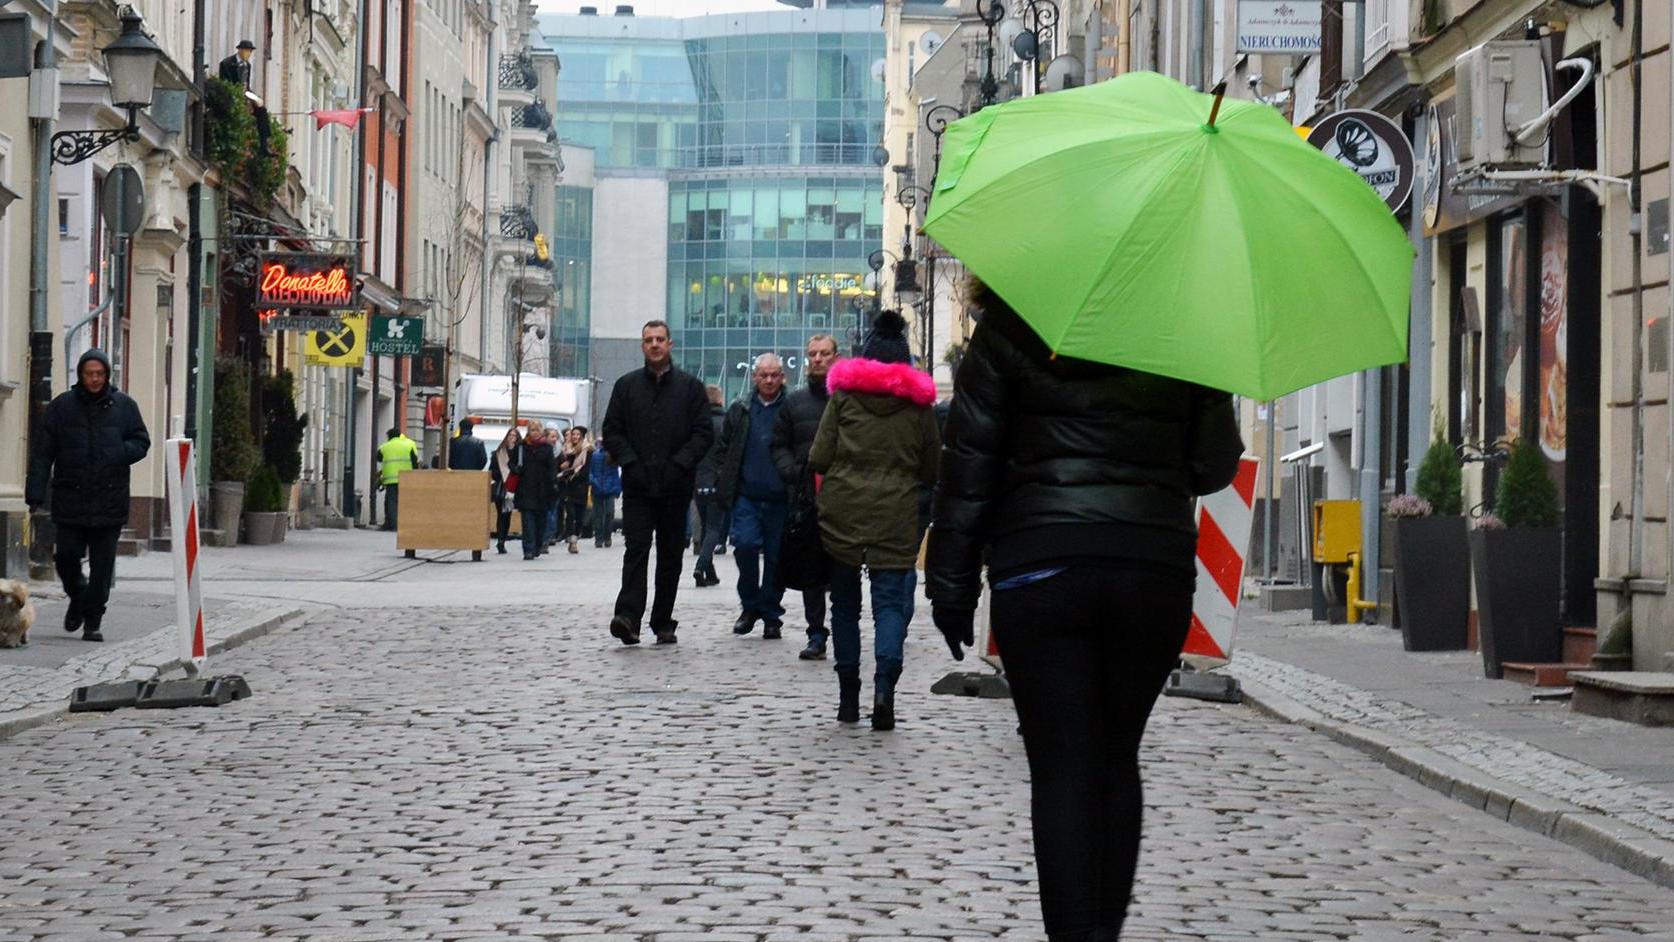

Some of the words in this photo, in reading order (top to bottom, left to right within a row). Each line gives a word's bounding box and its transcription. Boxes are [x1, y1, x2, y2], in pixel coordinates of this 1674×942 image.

[262, 264, 347, 293] Donatello
[811, 274, 857, 289] foodie
[272, 318, 340, 331] TRATTORIA
[371, 341, 419, 354] HOSTEL
